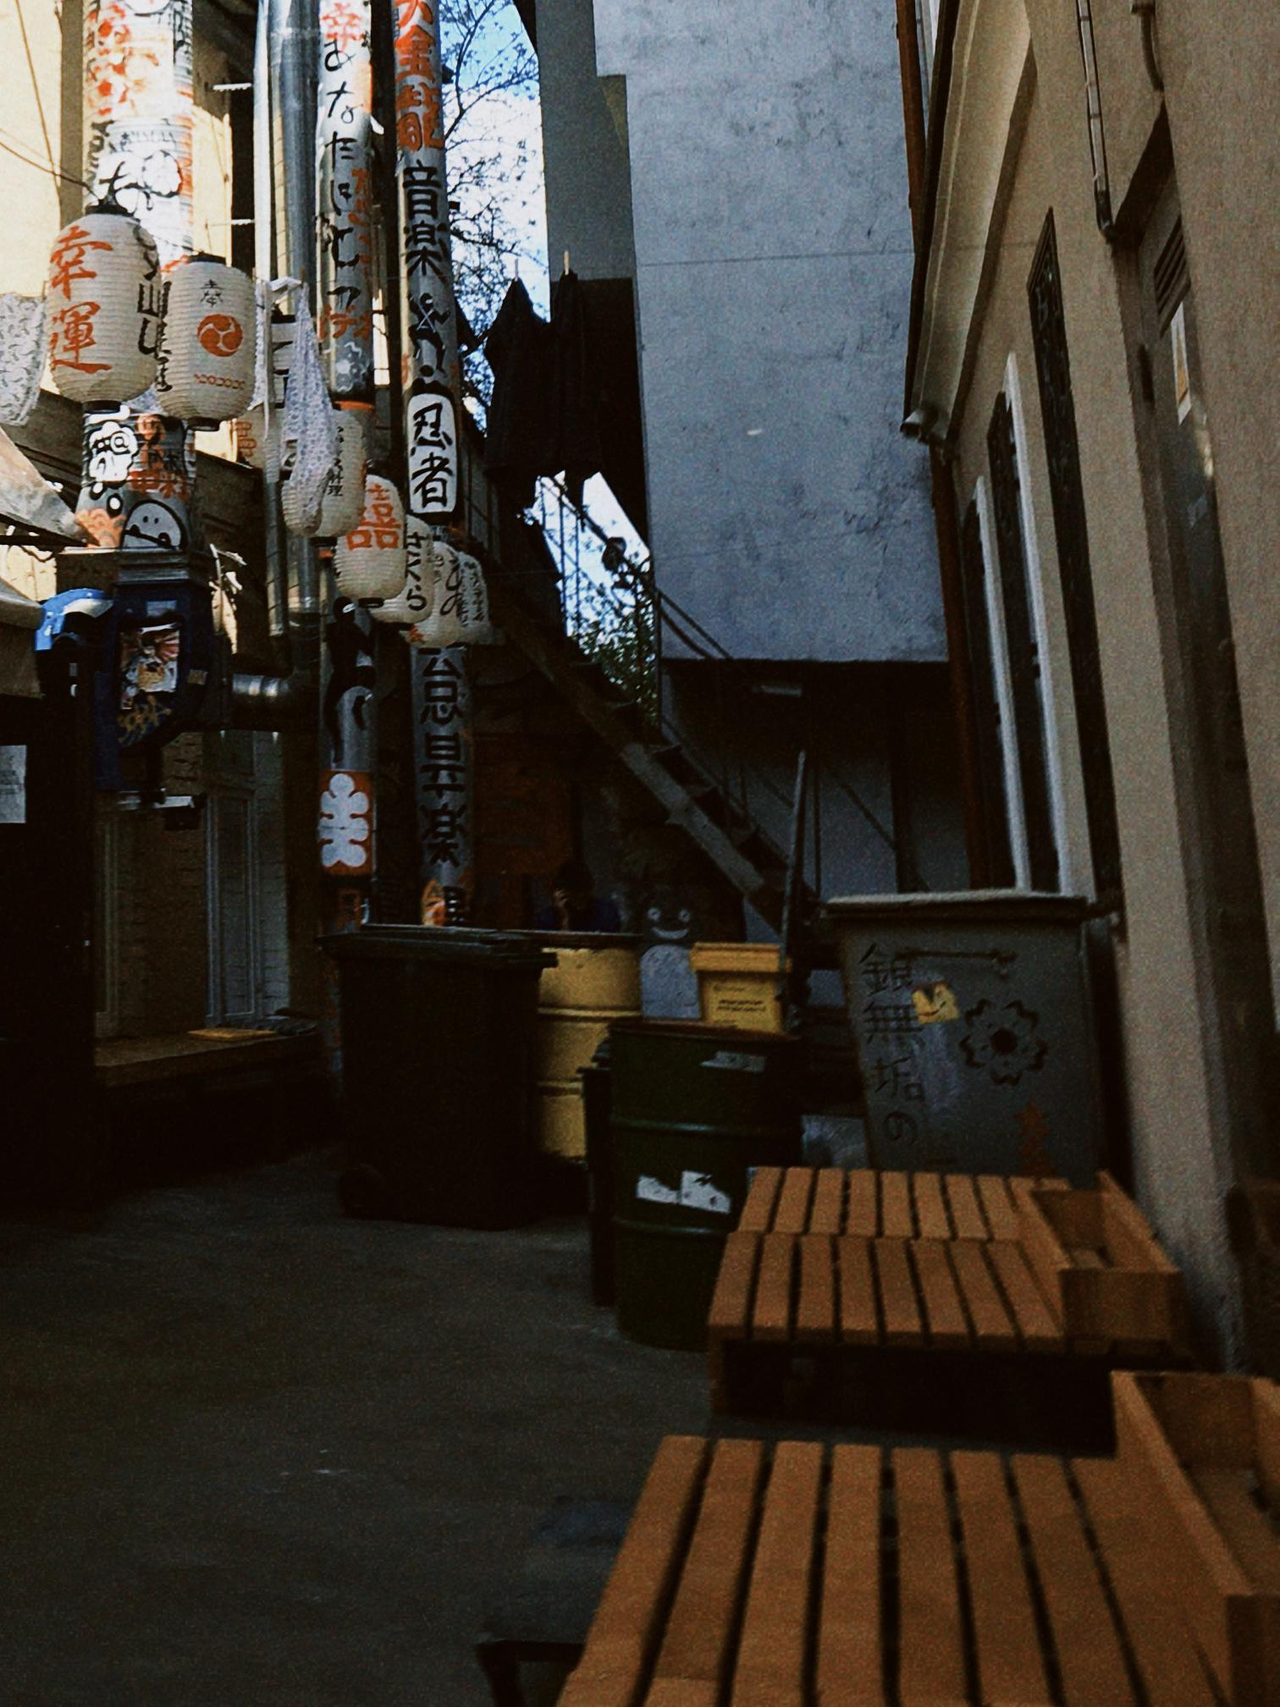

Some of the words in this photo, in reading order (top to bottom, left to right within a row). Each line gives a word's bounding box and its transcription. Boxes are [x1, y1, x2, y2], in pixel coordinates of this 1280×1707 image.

[403, 159, 452, 285] 音楽
[49, 224, 114, 374] 幸運
[409, 402, 455, 509] 忍者
